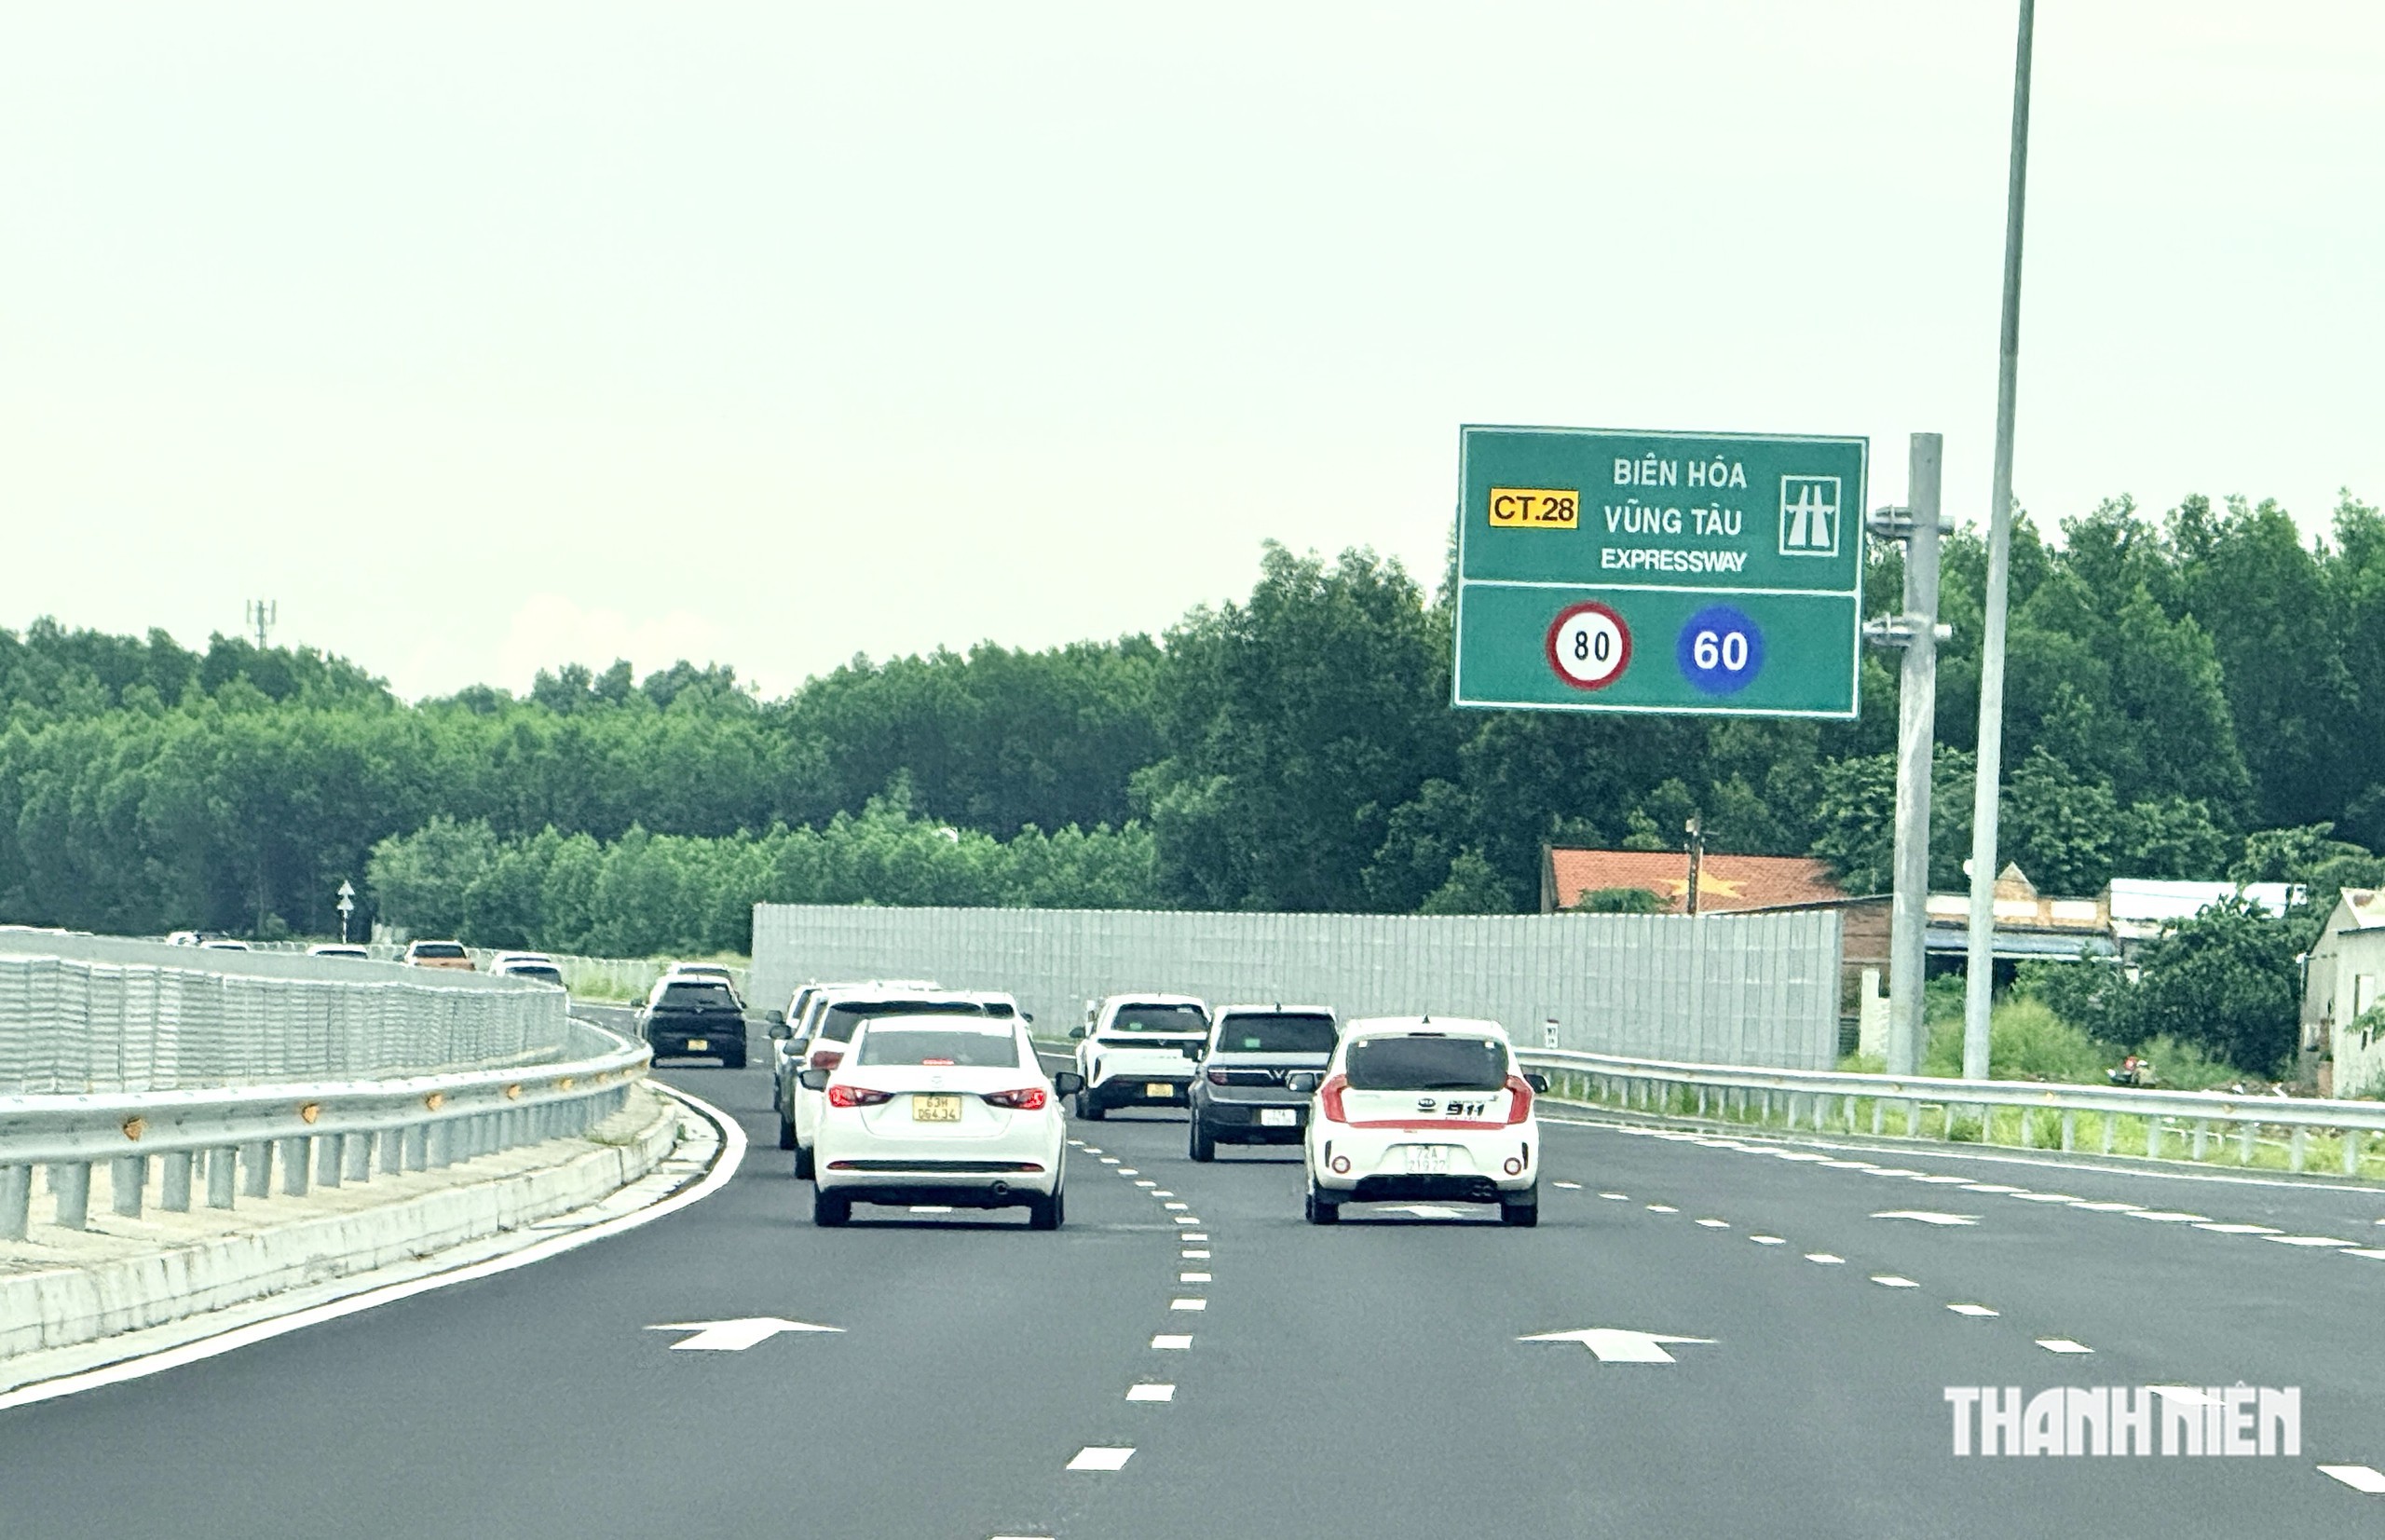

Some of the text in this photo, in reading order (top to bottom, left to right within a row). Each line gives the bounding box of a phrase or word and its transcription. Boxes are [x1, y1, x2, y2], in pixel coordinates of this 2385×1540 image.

[1614, 452, 1748, 489] BIÊN HÒA
[1493, 496, 1575, 523] CT.28
[1604, 498, 1742, 536] VŨNG TÀU
[1601, 548, 1748, 572] EXPRESSWAY
[1574, 630, 1610, 661] 80
[1693, 631, 1749, 671] 60
